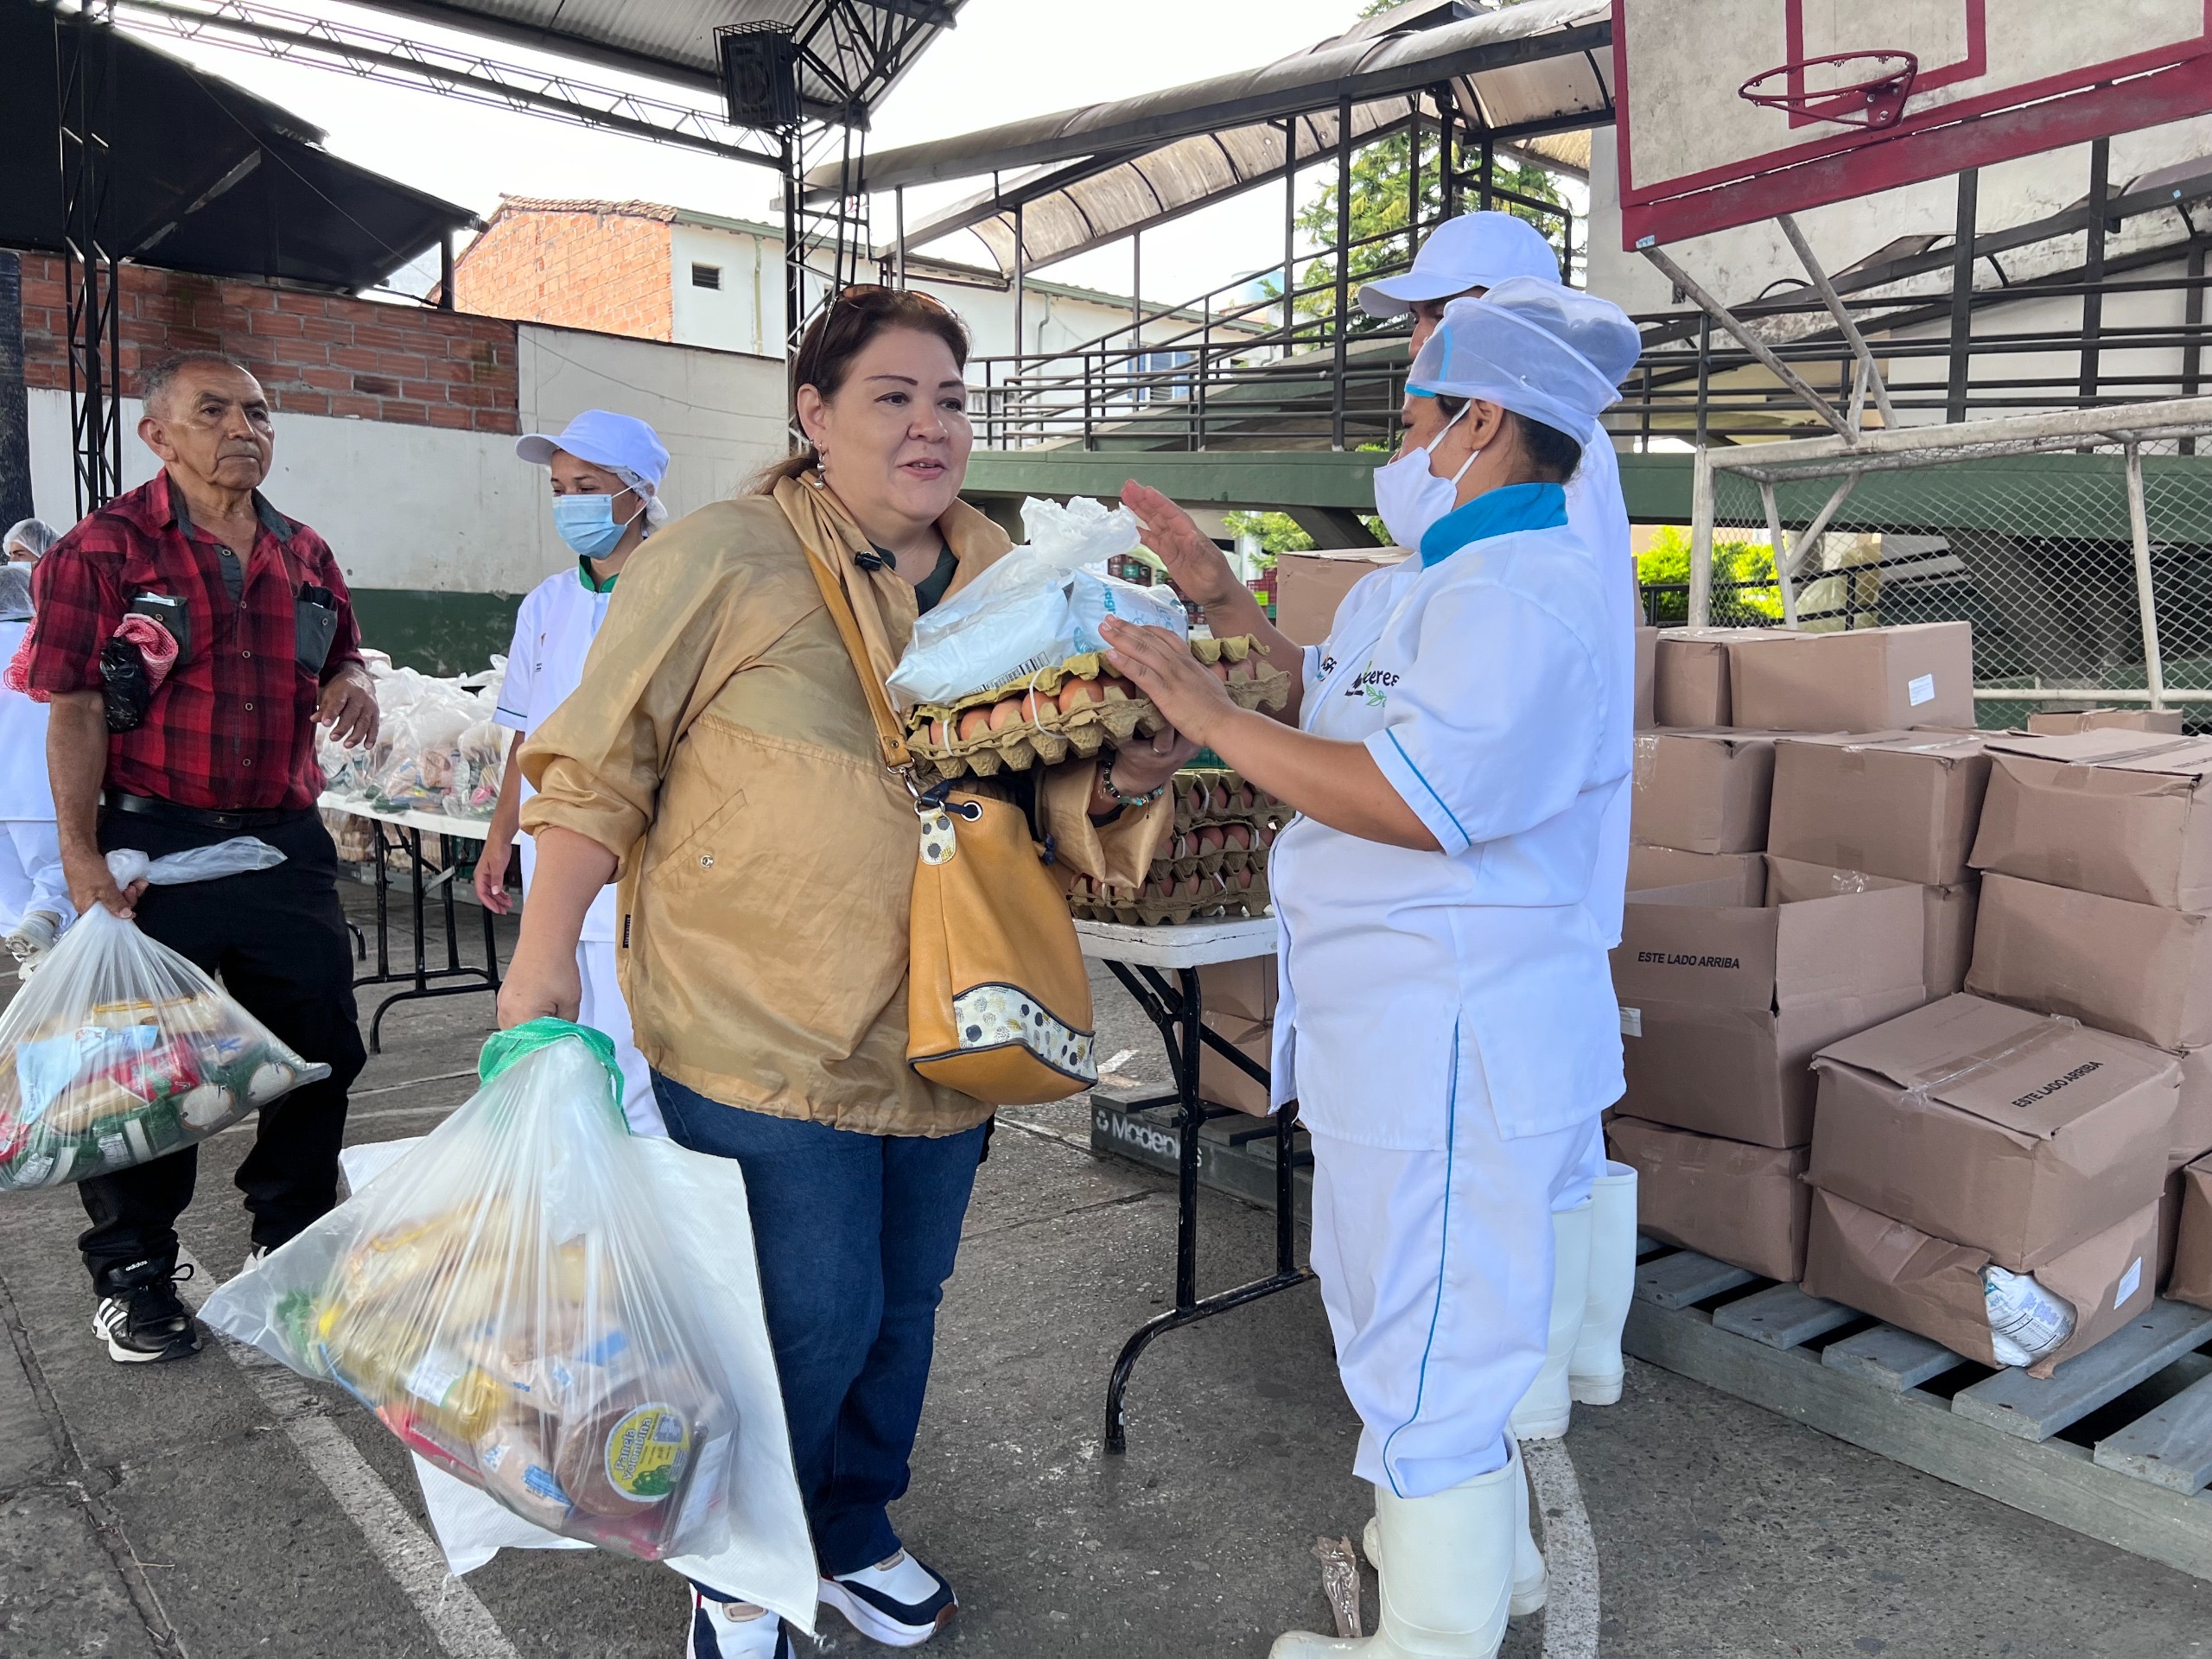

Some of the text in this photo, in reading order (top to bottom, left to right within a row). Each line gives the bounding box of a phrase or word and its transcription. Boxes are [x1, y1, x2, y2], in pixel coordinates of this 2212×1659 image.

[1637, 951, 1740, 969] ESTE LADO ARRIBA
[2011, 1061, 2104, 1108] ESTE LADO ARRIBA
[125, 1260, 148, 1272] adidas
[614, 1428, 636, 1470] Panela
